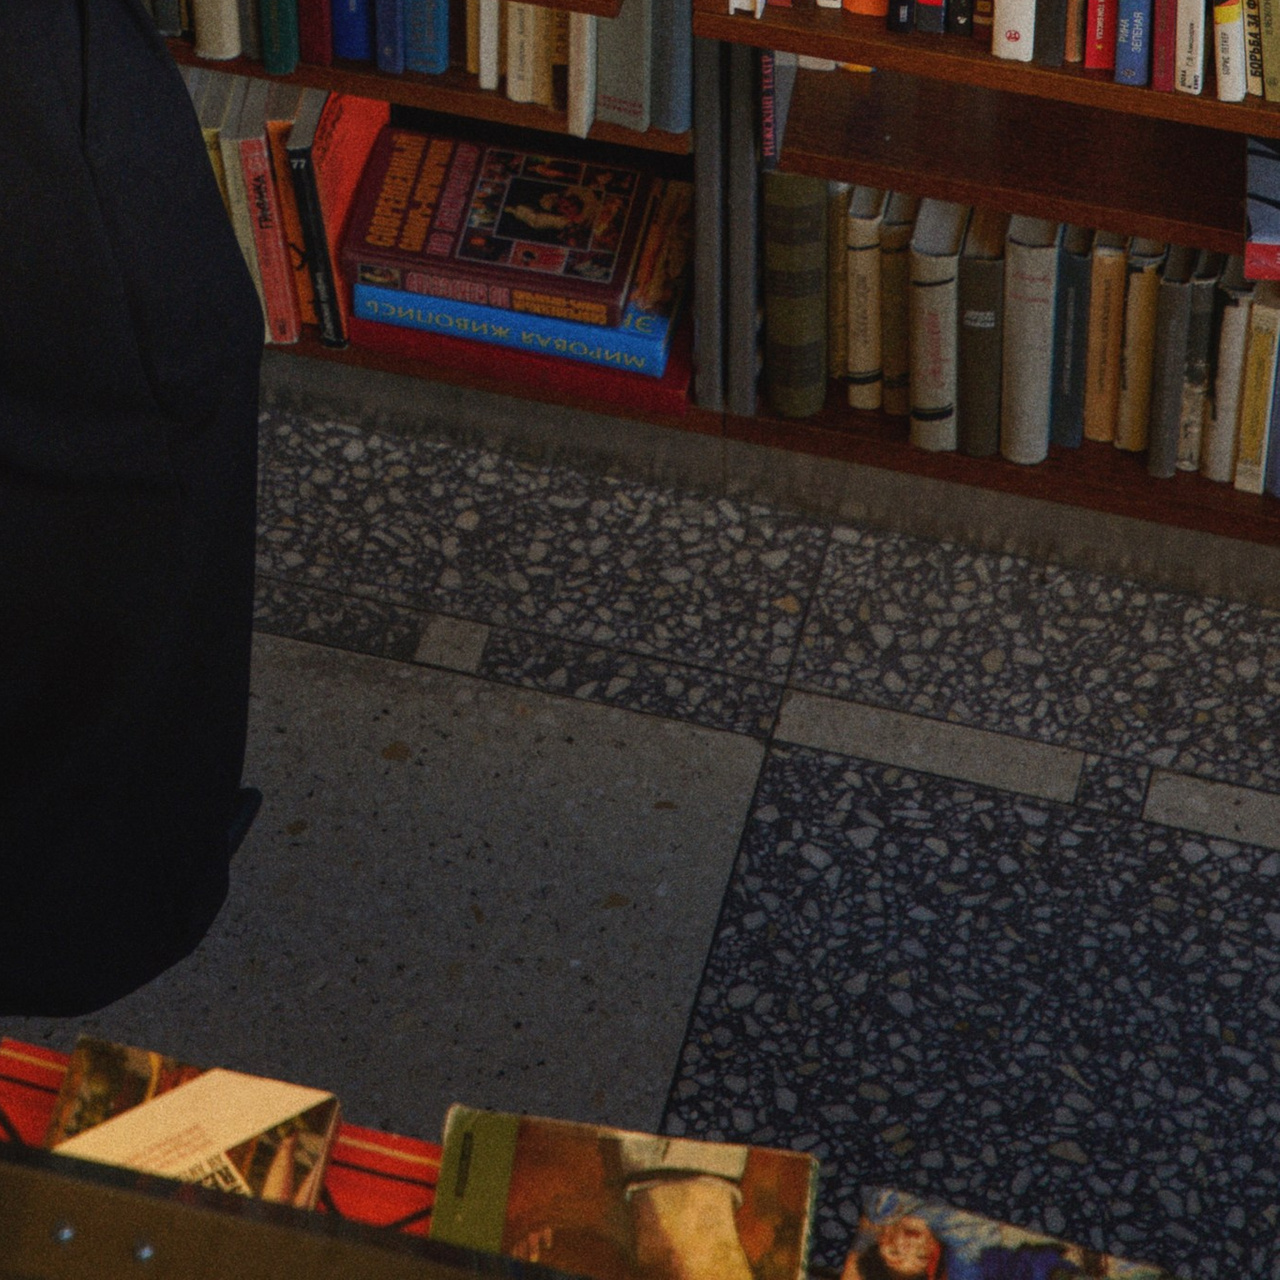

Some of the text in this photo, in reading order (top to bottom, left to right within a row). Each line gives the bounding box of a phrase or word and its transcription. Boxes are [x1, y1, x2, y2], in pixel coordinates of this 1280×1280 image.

[1117, 16, 1129, 44] РИНА
[1245, 9, 1260, 28] ЗА
[1246, 29, 1263, 78] БОРЬБА
[363, 125, 429, 251] СОВРЕМЕННЫЙ
[361, 297, 647, 370] МИРОВАЯ ЖИВОПИСЬ
